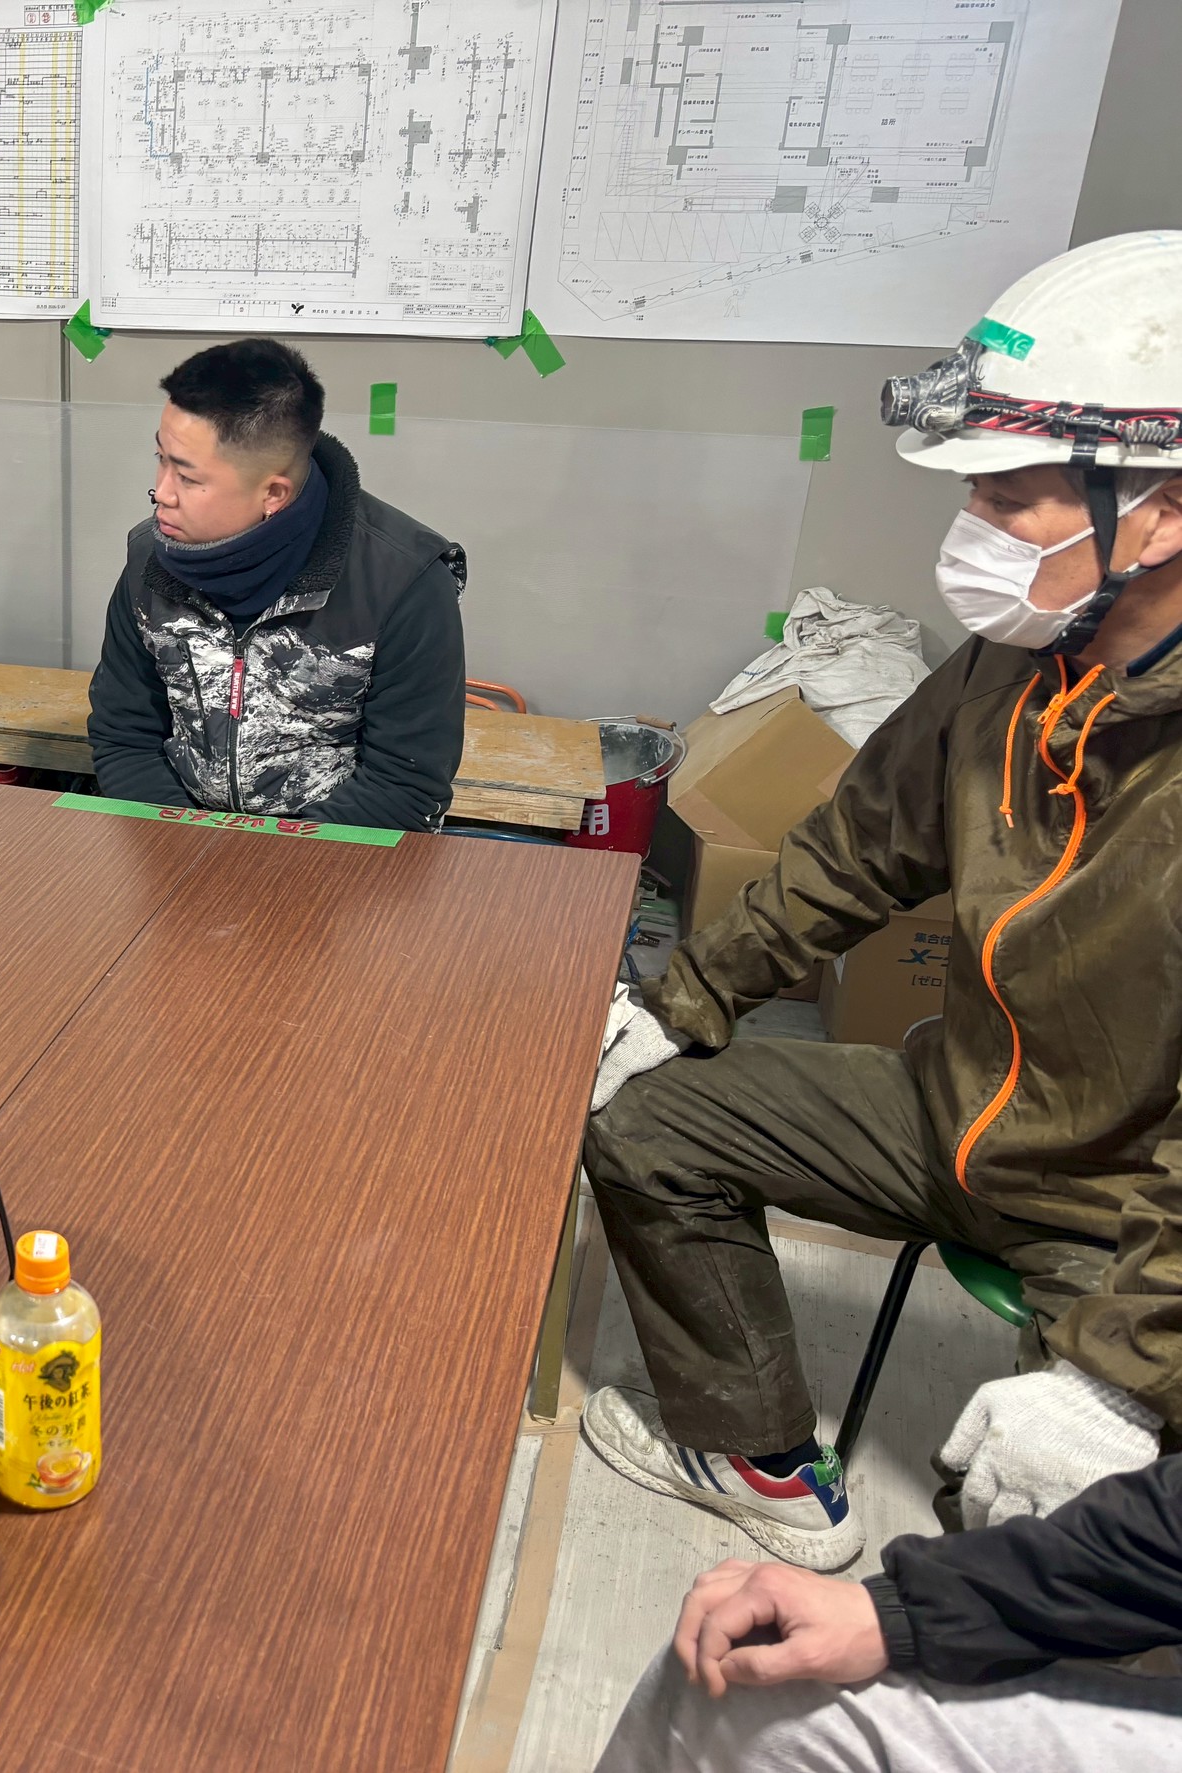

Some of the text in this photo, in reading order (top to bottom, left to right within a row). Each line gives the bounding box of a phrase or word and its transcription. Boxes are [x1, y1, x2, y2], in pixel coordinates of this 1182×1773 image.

[880, 118, 897, 127] 詰所
[573, 803, 610, 836] 用
[23, 1381, 91, 1411] 午後の紅茶
